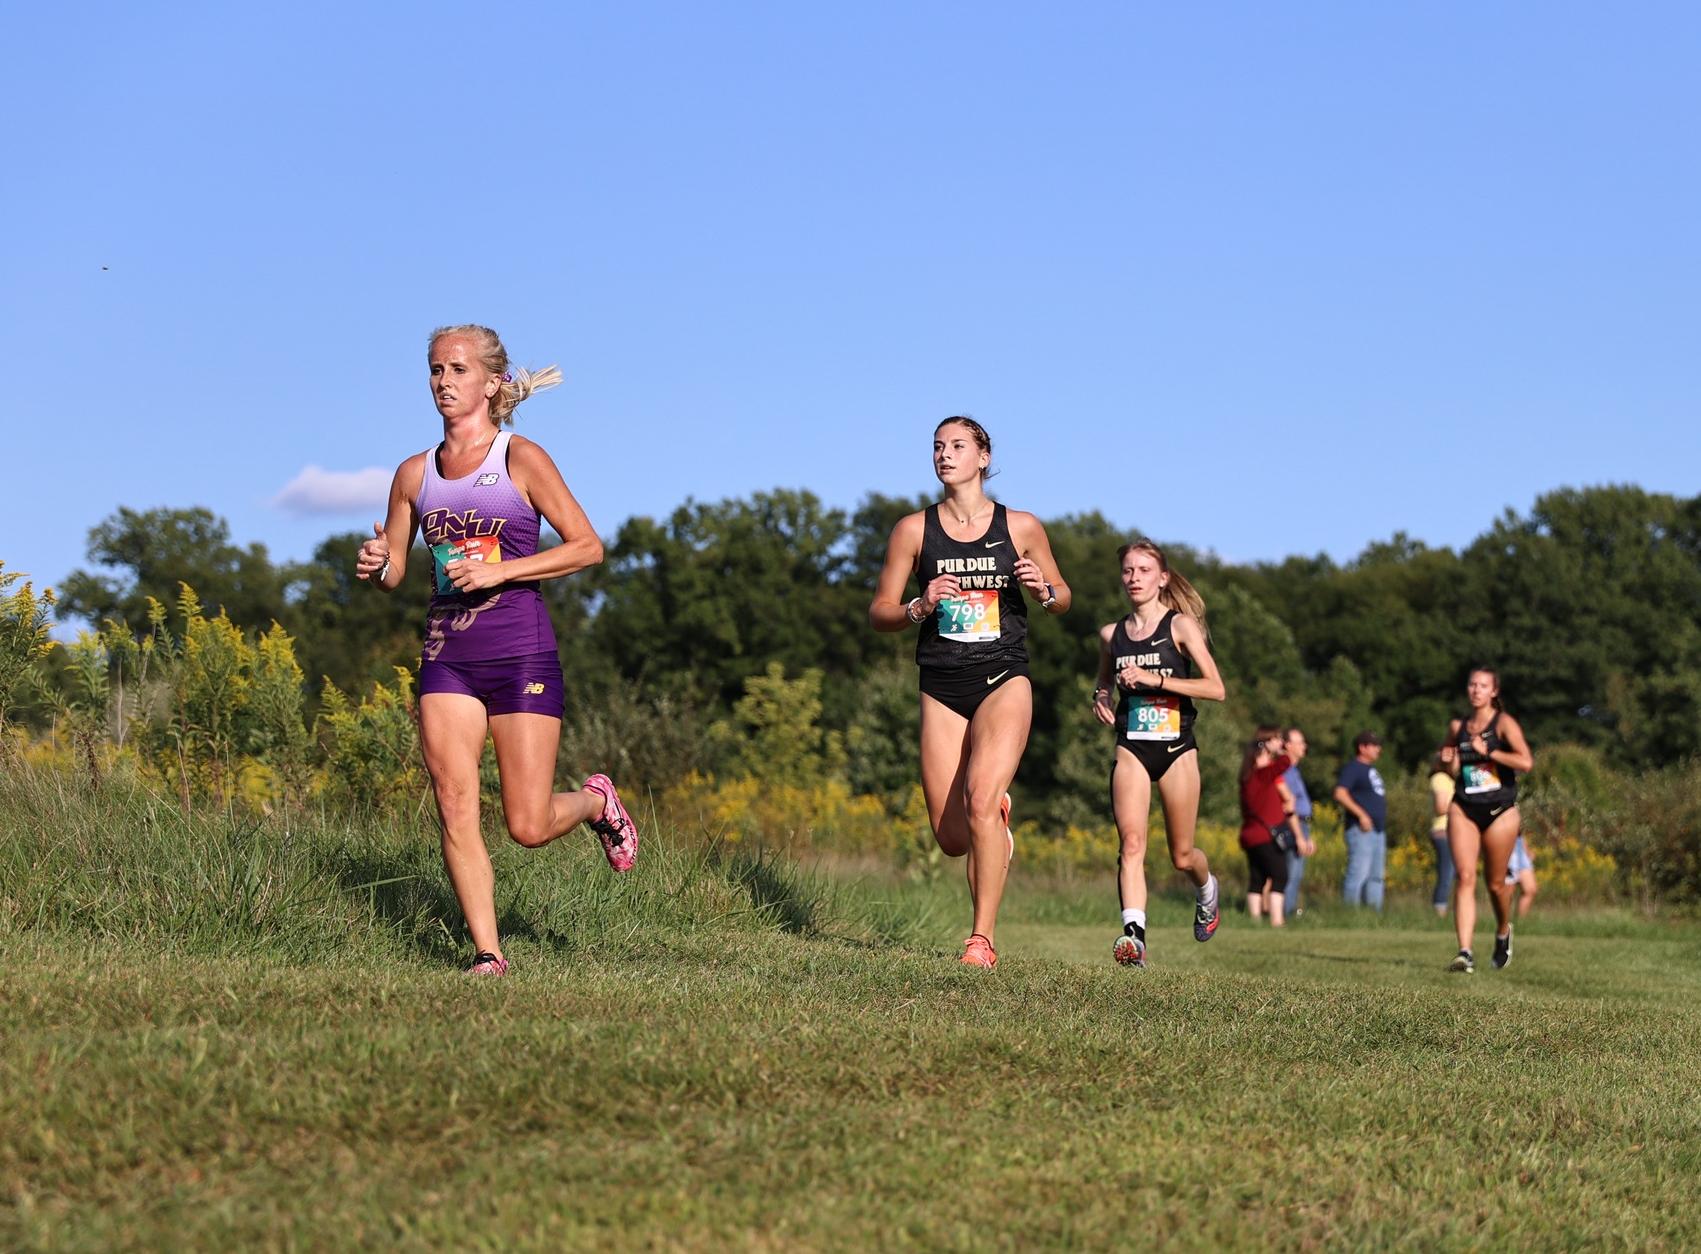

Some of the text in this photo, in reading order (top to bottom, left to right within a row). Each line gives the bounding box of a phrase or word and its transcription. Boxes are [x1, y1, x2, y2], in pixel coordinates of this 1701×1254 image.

[422, 508, 507, 540] ONU
[936, 556, 997, 574] PURDUE
[957, 574, 1009, 589] HWEST
[949, 603, 985, 622] 798
[1116, 653, 1161, 669] PURDUE
[1138, 707, 1168, 722] 805
